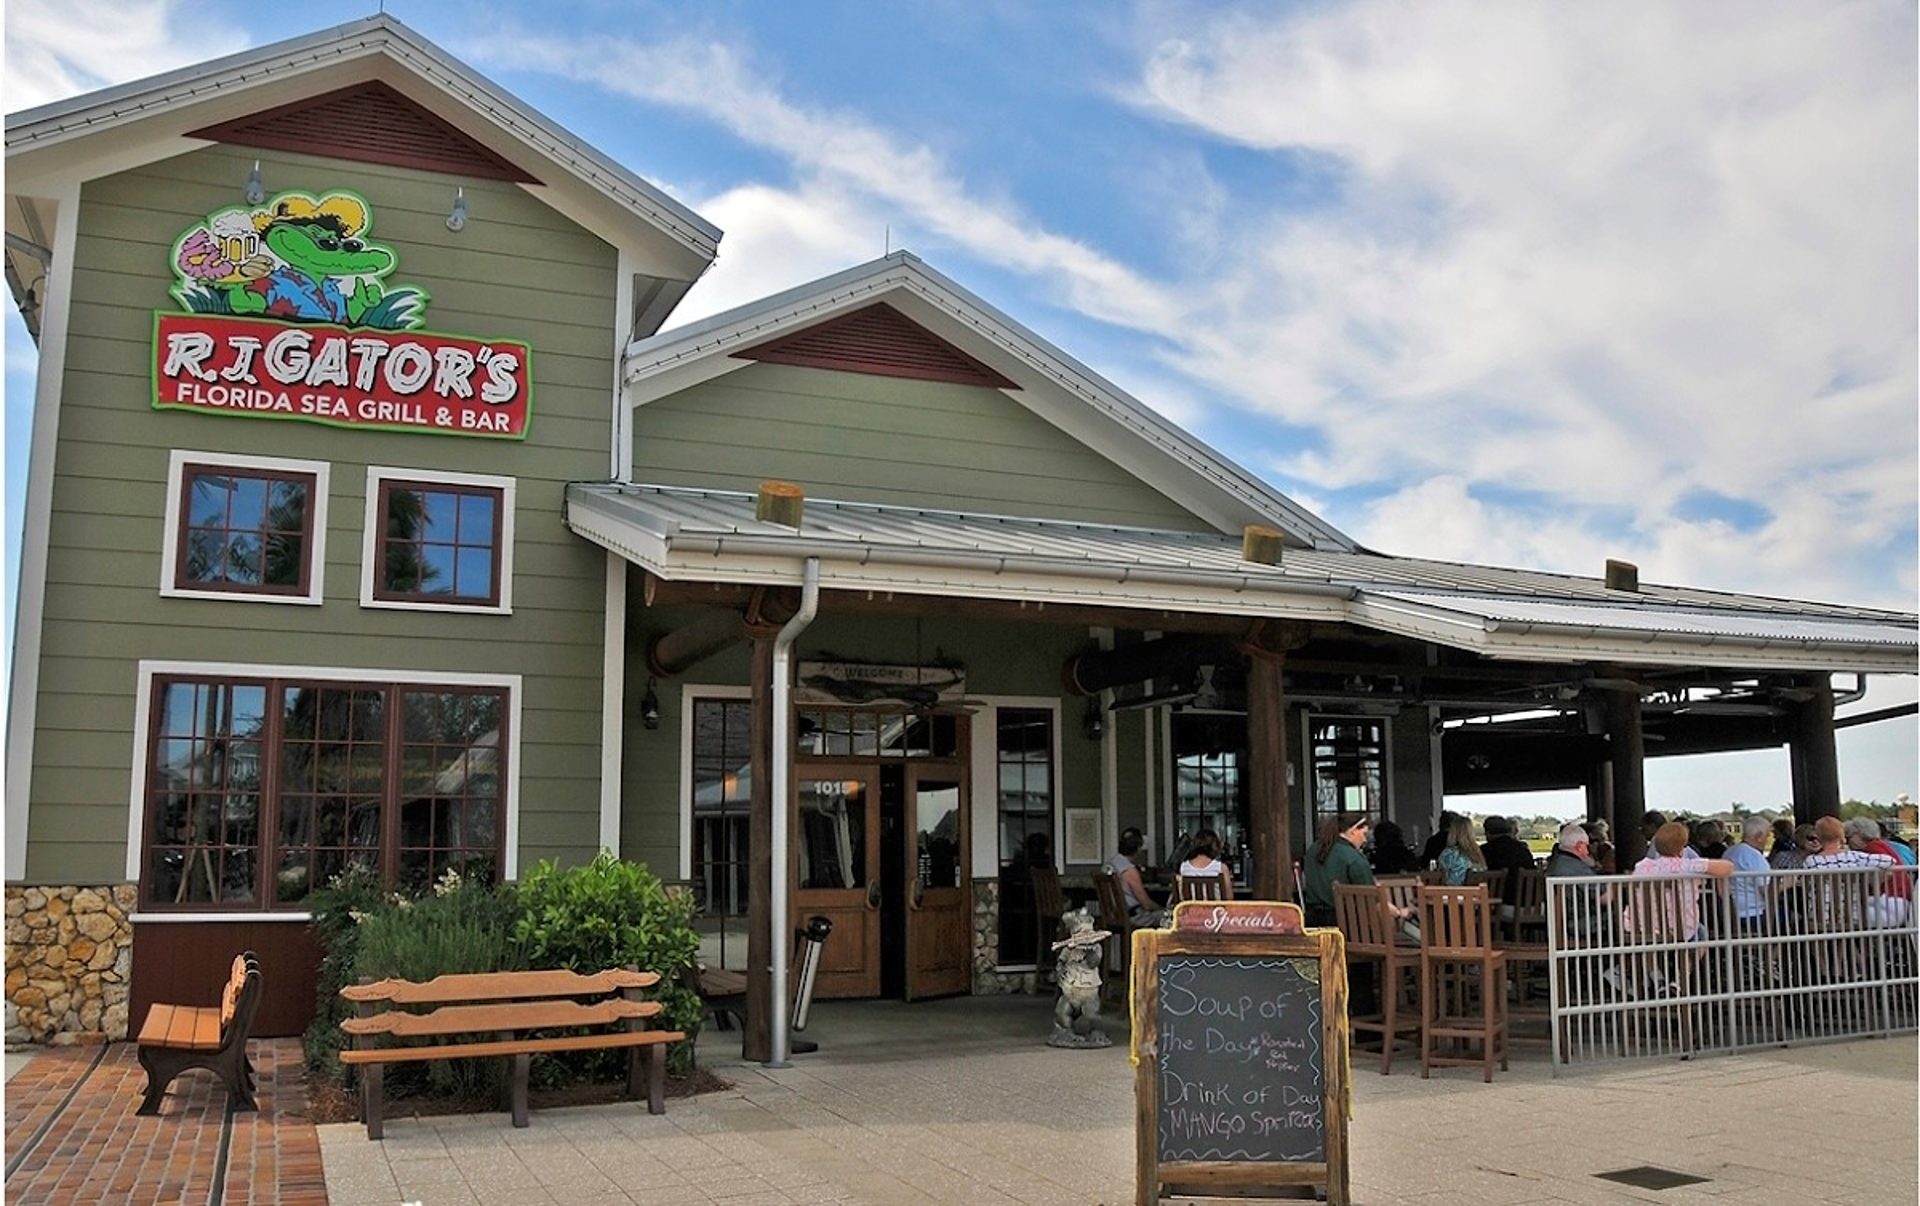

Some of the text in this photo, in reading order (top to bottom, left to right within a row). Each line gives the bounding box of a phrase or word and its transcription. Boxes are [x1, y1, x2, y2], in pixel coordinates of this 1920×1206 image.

[177, 383, 510, 432] FLORIDA SEA GRILL & BAR
[845, 666, 904, 679] WELCOME
[1204, 906, 1274, 933] Specials
[1163, 968, 1292, 1021] Soup of
[1161, 1022, 1195, 1052] the
[1243, 1085, 1272, 1104] of
[1282, 1085, 1321, 1114] Day
[1170, 1108, 1245, 1140] MANGO
